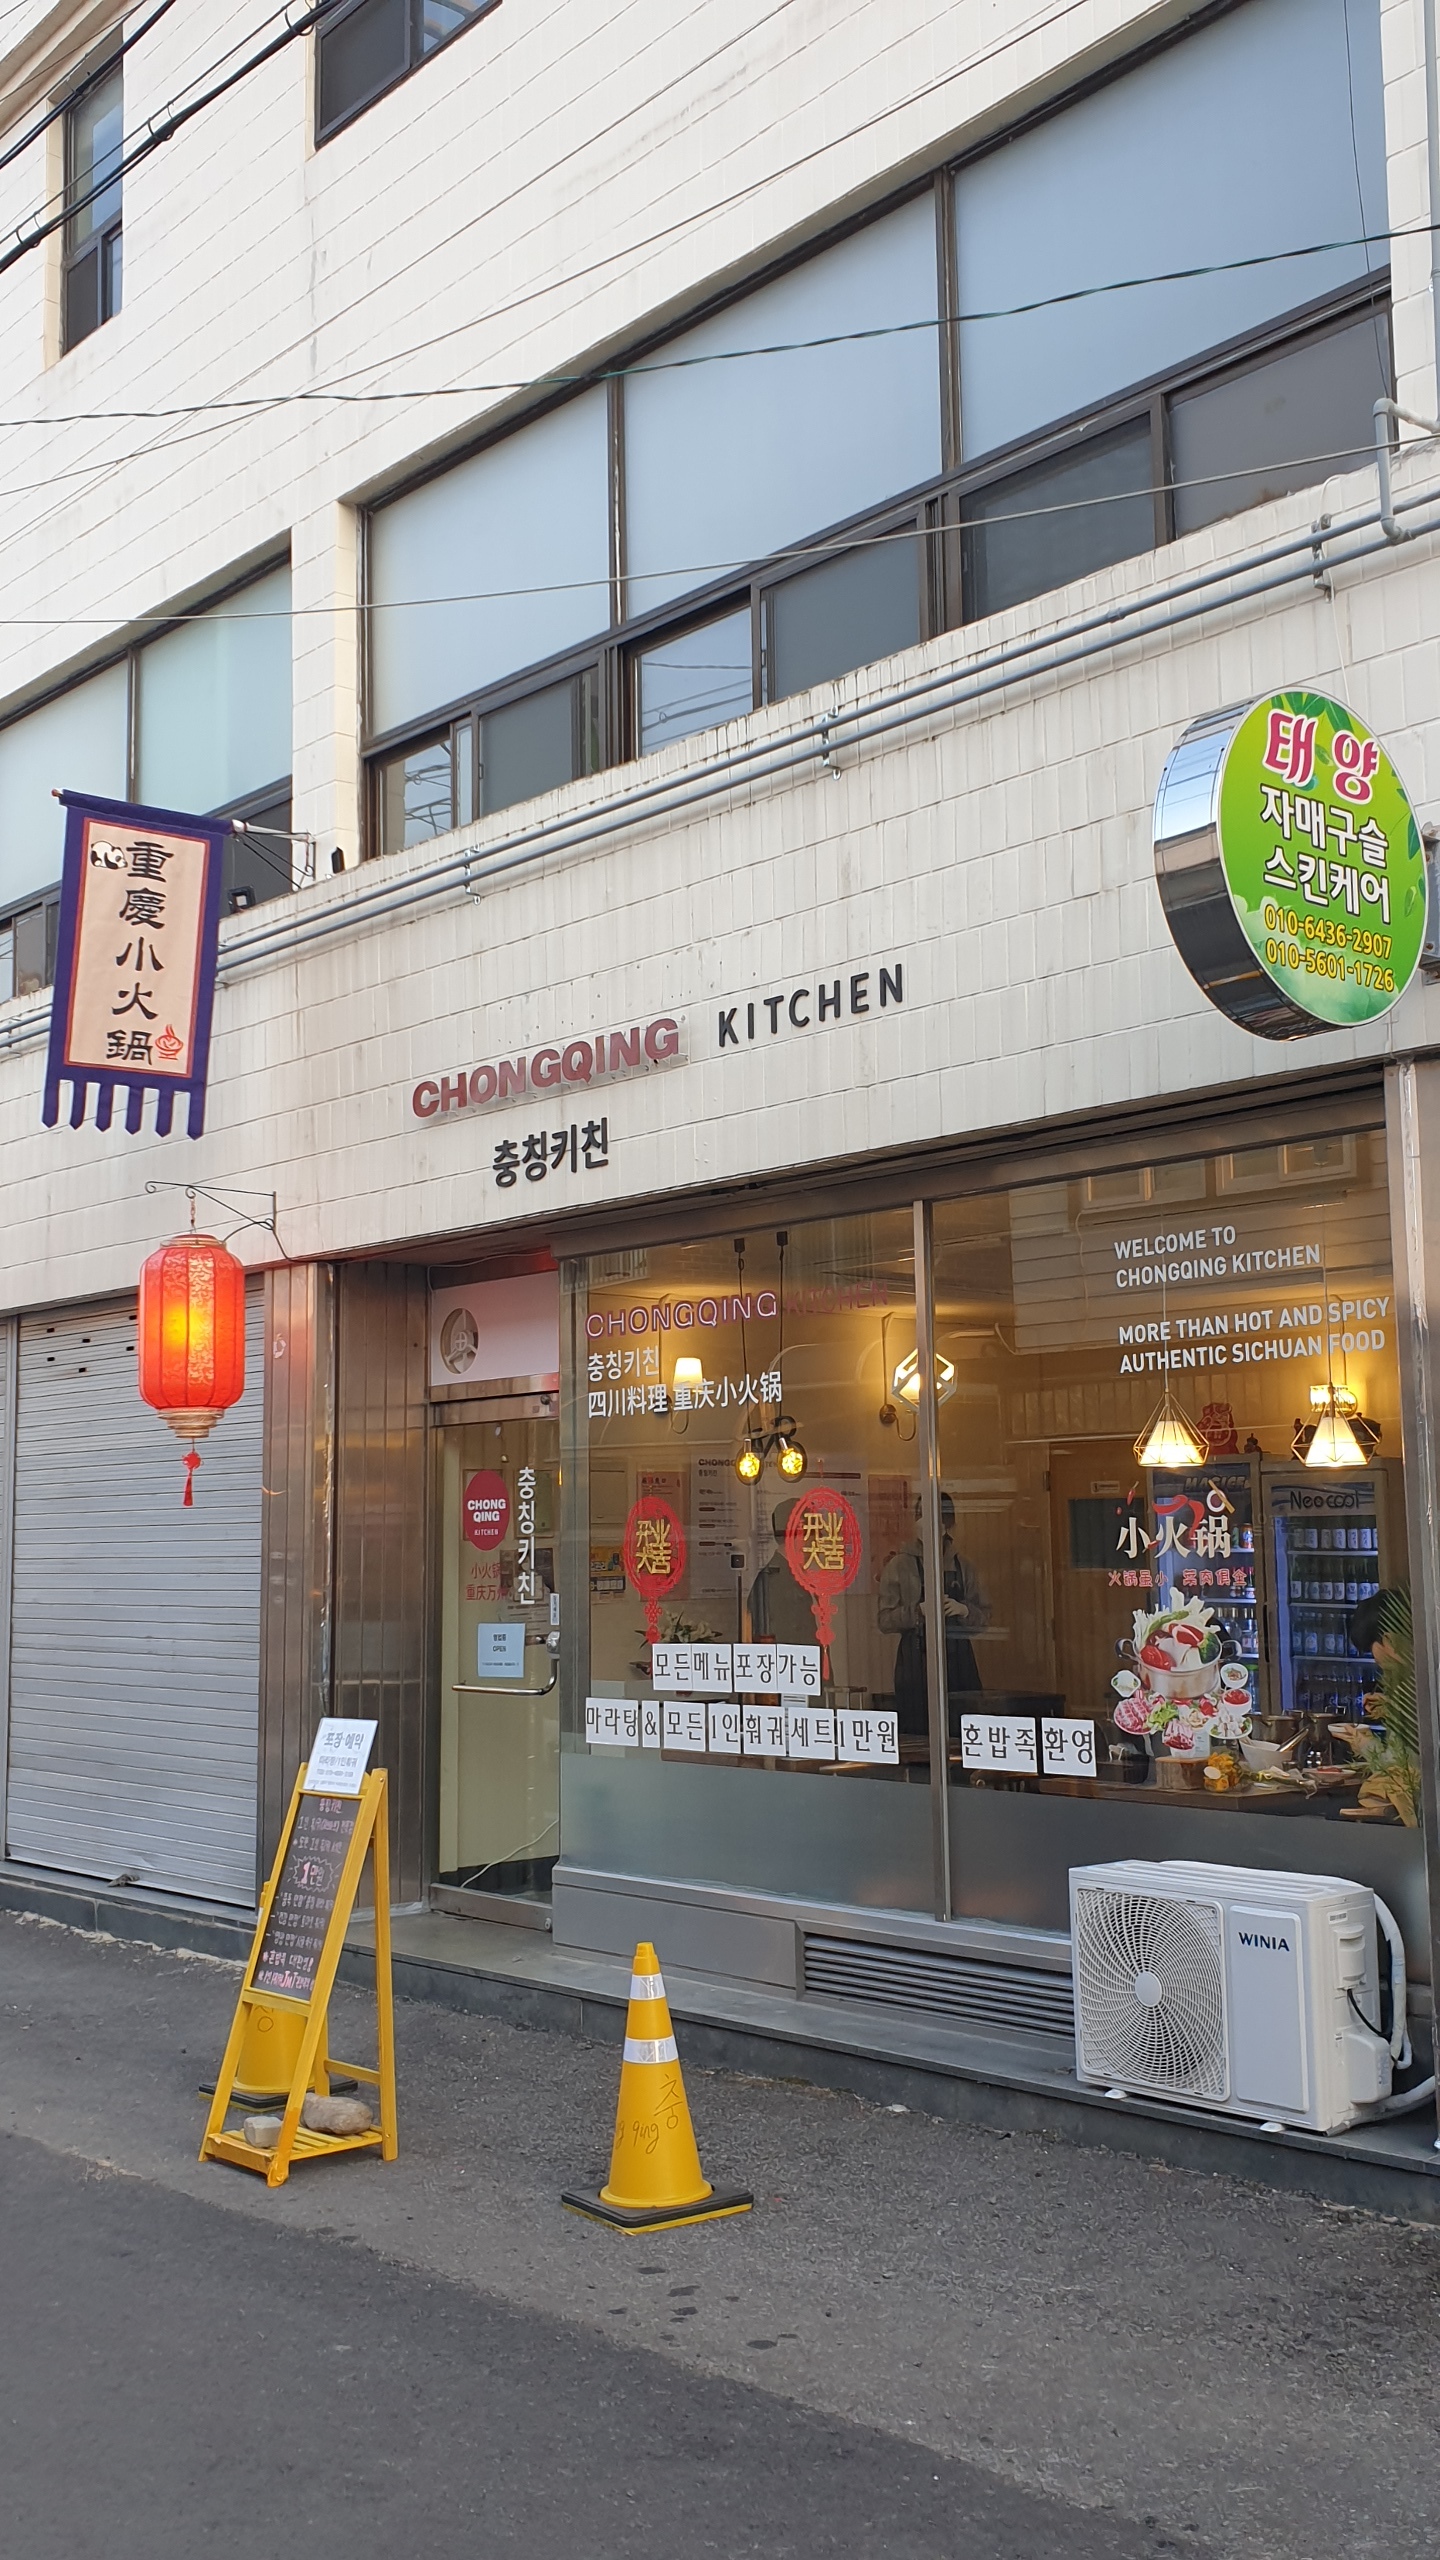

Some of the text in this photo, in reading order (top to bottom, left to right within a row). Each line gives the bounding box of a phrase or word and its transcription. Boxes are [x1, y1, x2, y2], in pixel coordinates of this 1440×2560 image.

[1260, 784, 1389, 868] 자매구슬
[1263, 847, 1391, 924] 스킨케어
[106, 841, 174, 1065] 重慶小火鍋
[1264, 904, 1393, 959] 010-6436-2907
[1266, 938, 1395, 992] 010-5601-1726
[412, 963, 904, 1118] CHONGQING KITCHEN
[492, 1117, 610, 1188] 충칭키친
[1114, 1226, 1236, 1259] WELCOME TO
[1116, 1244, 1321, 1288] CHONGQING KITCHEN
[585, 1291, 778, 1339] CHONGQING
[1118, 1297, 1390, 1345] MORE THAN HOT AND SPICY
[587, 1345, 660, 1382] 충칭키친
[1120, 1329, 1385, 1374] AUTHENTIC SICHUAN FOOD
[588, 1370, 783, 1418] 四川料理 重庆小火锅
[467, 1499, 506, 1511] CHONG
[473, 1511, 500, 1523] QING
[474, 1528, 499, 1536] KITCHEN
[517, 1466, 537, 1605] 충칭키친
[1116, 1514, 1232, 1559] 小火锅
[586, 1705, 897, 1754] 마라탕 & 모든 1인 훠궈 세트 1만원
[963, 1724, 1093, 1764] 혼밥족 환영
[1238, 1932, 1290, 1952] WINIA
[653, 2073, 684, 2129] 충
[632, 2120, 660, 2154] qing
